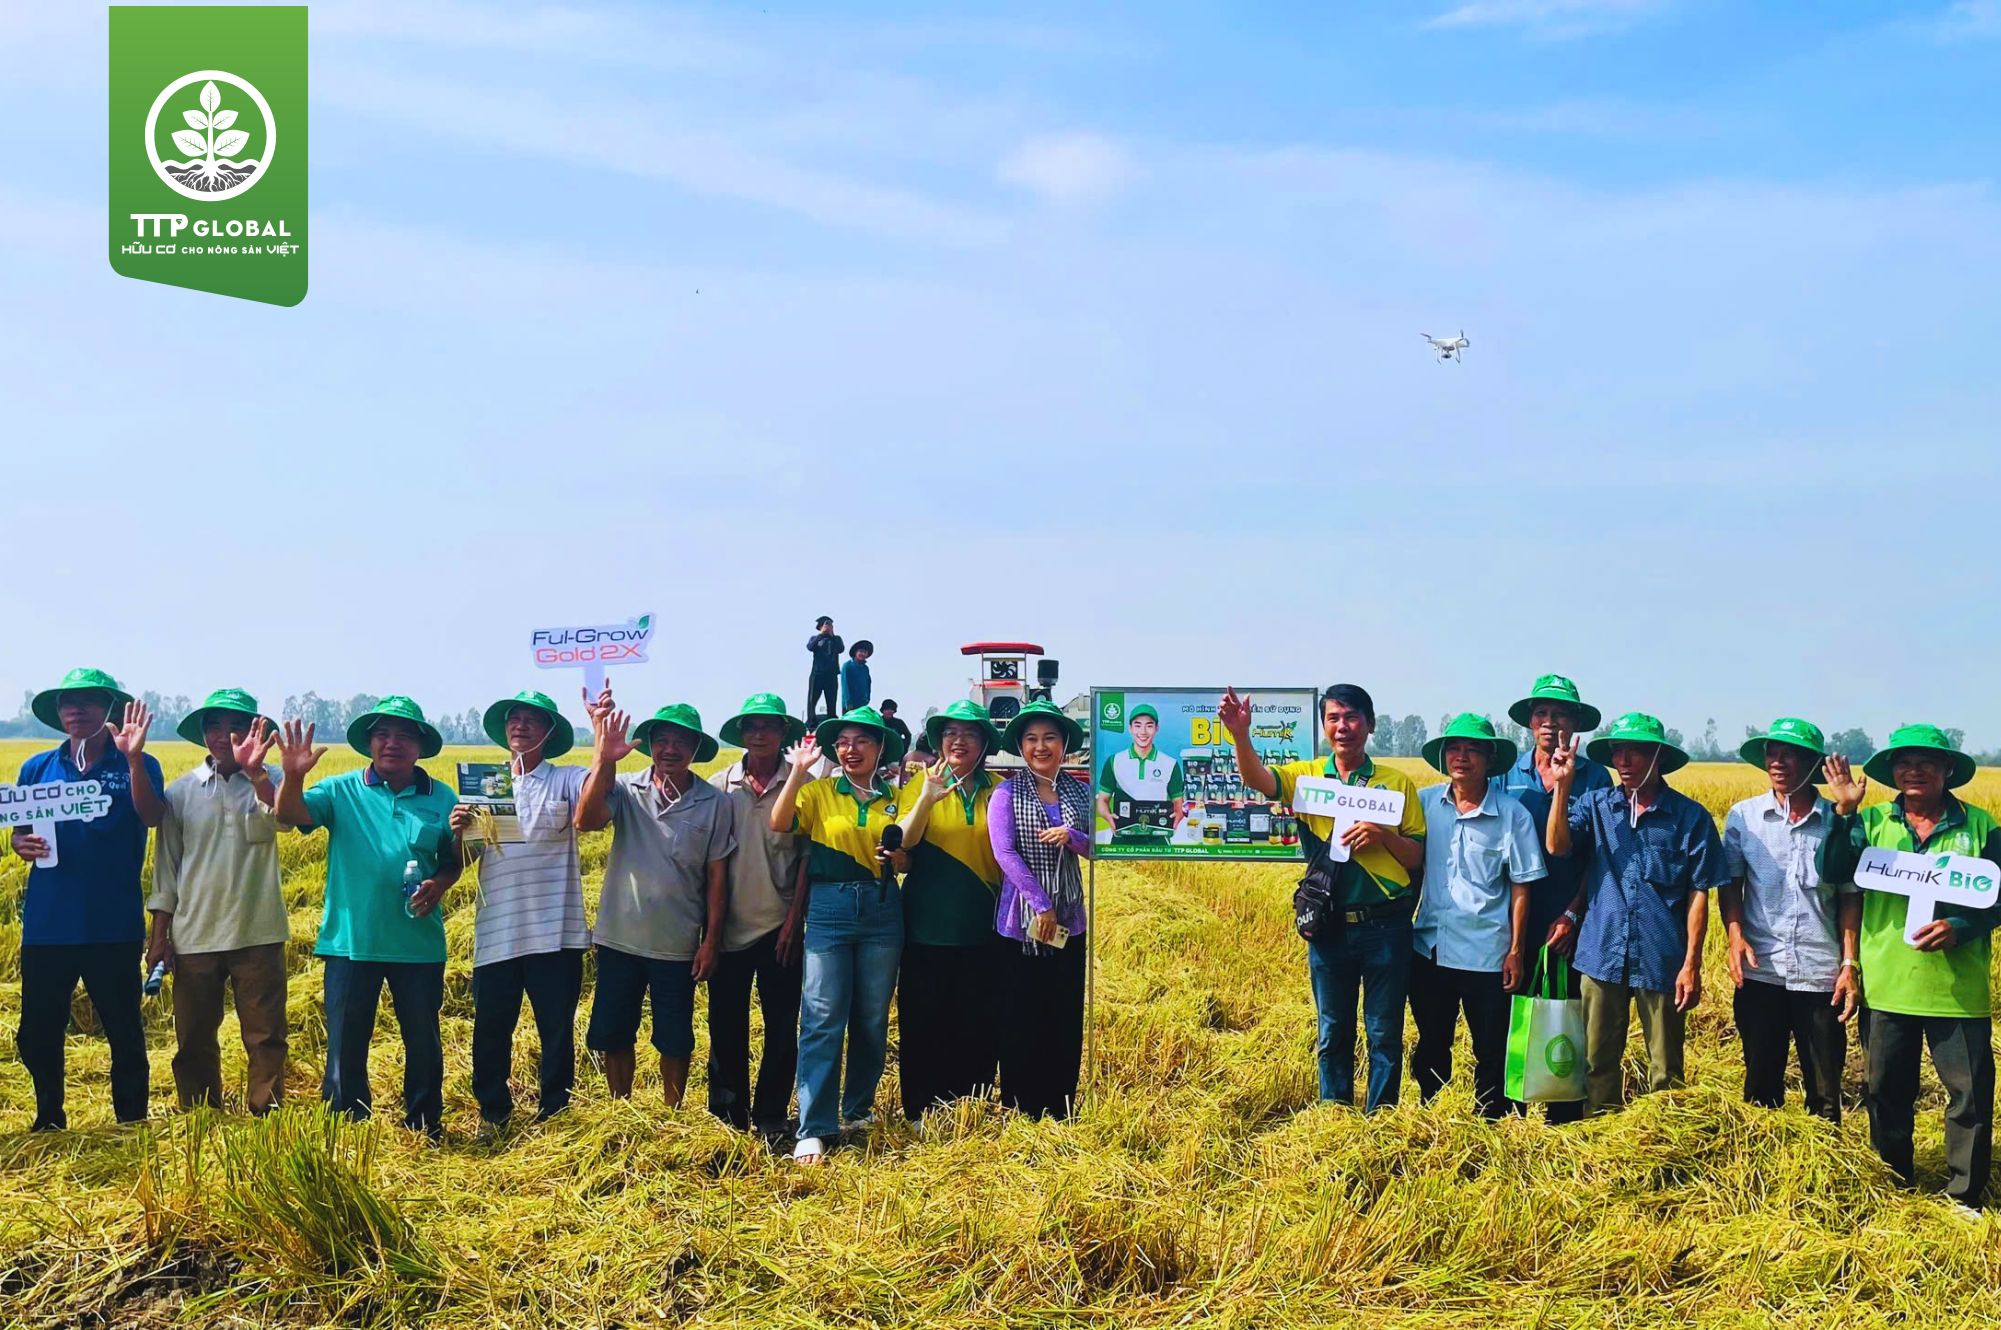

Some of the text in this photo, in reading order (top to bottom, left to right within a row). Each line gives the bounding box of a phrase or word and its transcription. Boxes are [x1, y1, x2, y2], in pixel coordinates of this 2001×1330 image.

[532, 628, 649, 646] Ful-Grow
[535, 643, 642, 663] Gold 2X
[0, 784, 97, 804] ỮU CƠ CHO
[1302, 787, 1396, 813] TTP GLOBAL
[0, 812, 19, 823] NG
[61, 797, 107, 818] VIỆT
[1866, 860, 1943, 886] HumiK
